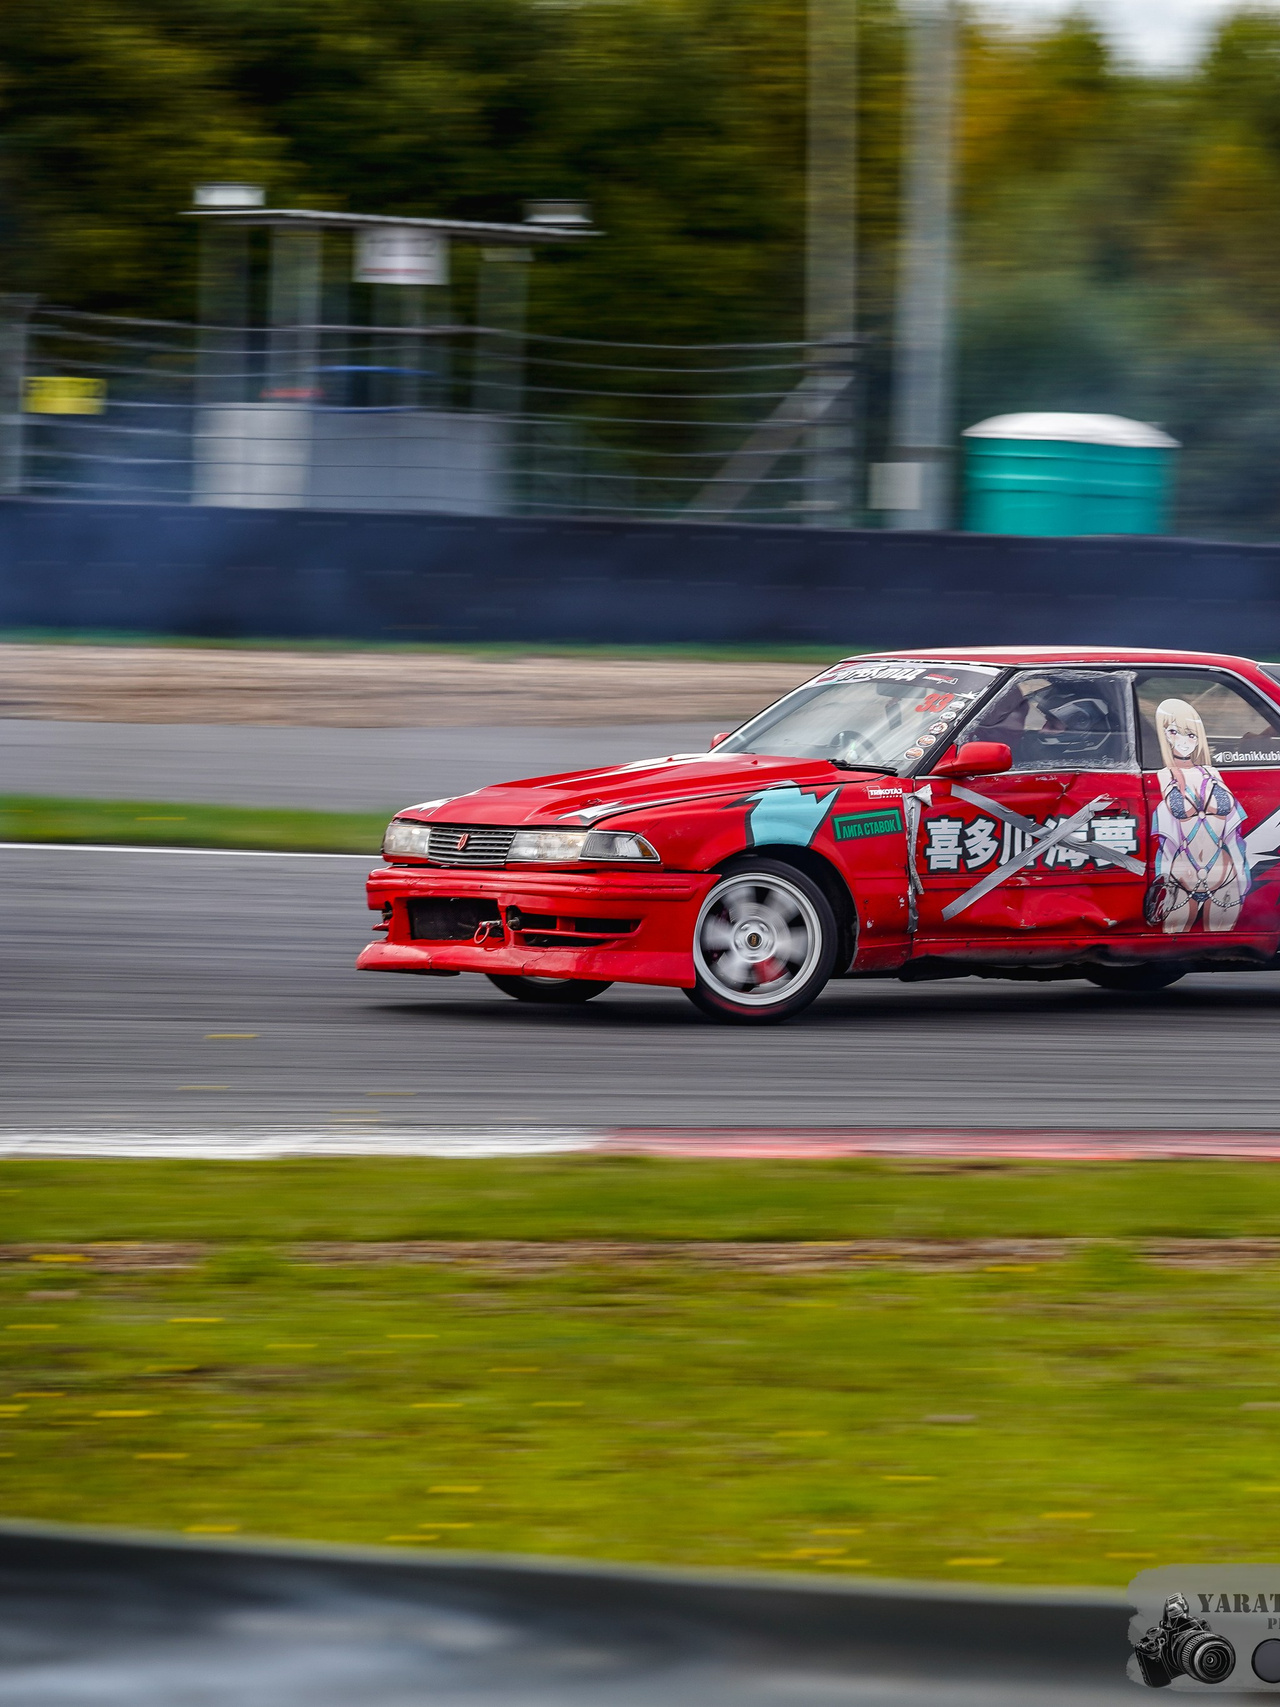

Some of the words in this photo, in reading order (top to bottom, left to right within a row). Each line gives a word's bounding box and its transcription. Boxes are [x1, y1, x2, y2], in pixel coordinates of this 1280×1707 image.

[915, 692, 955, 713] 33
[842, 823, 864, 839] ЛИГА
[863, 819, 897, 835] СТАВОК
